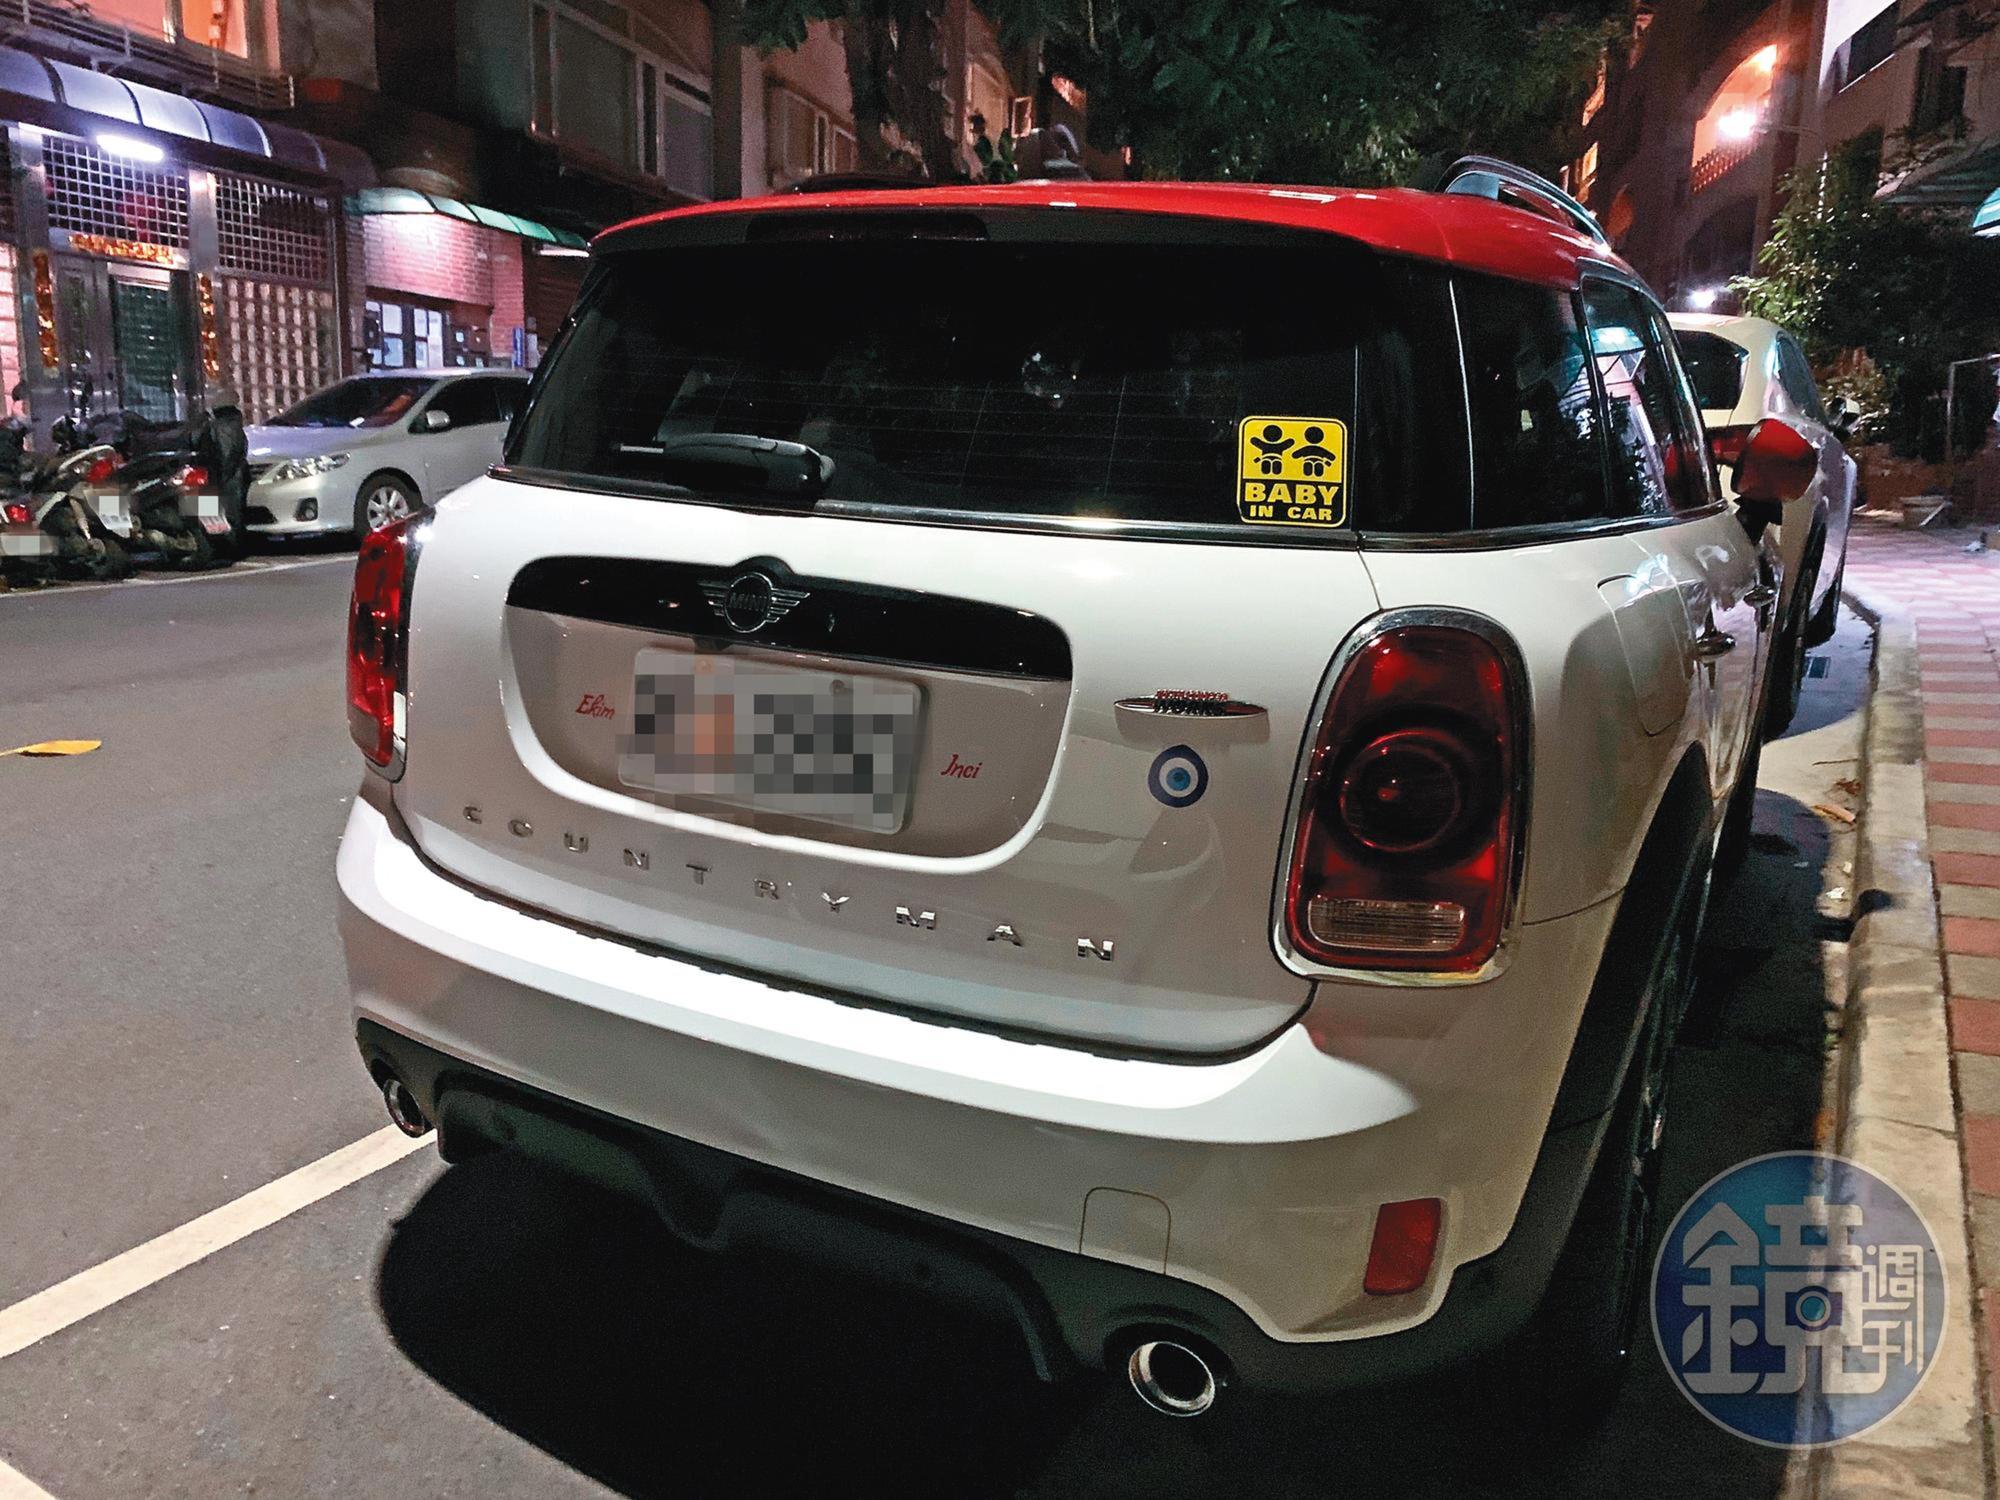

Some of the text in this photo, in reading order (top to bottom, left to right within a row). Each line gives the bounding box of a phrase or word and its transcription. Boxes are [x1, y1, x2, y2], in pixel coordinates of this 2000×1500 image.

[1245, 482, 1339, 505] BABY
[1250, 505, 1332, 520] IN CAR
[463, 806, 1114, 961] COUNTRYMAN
